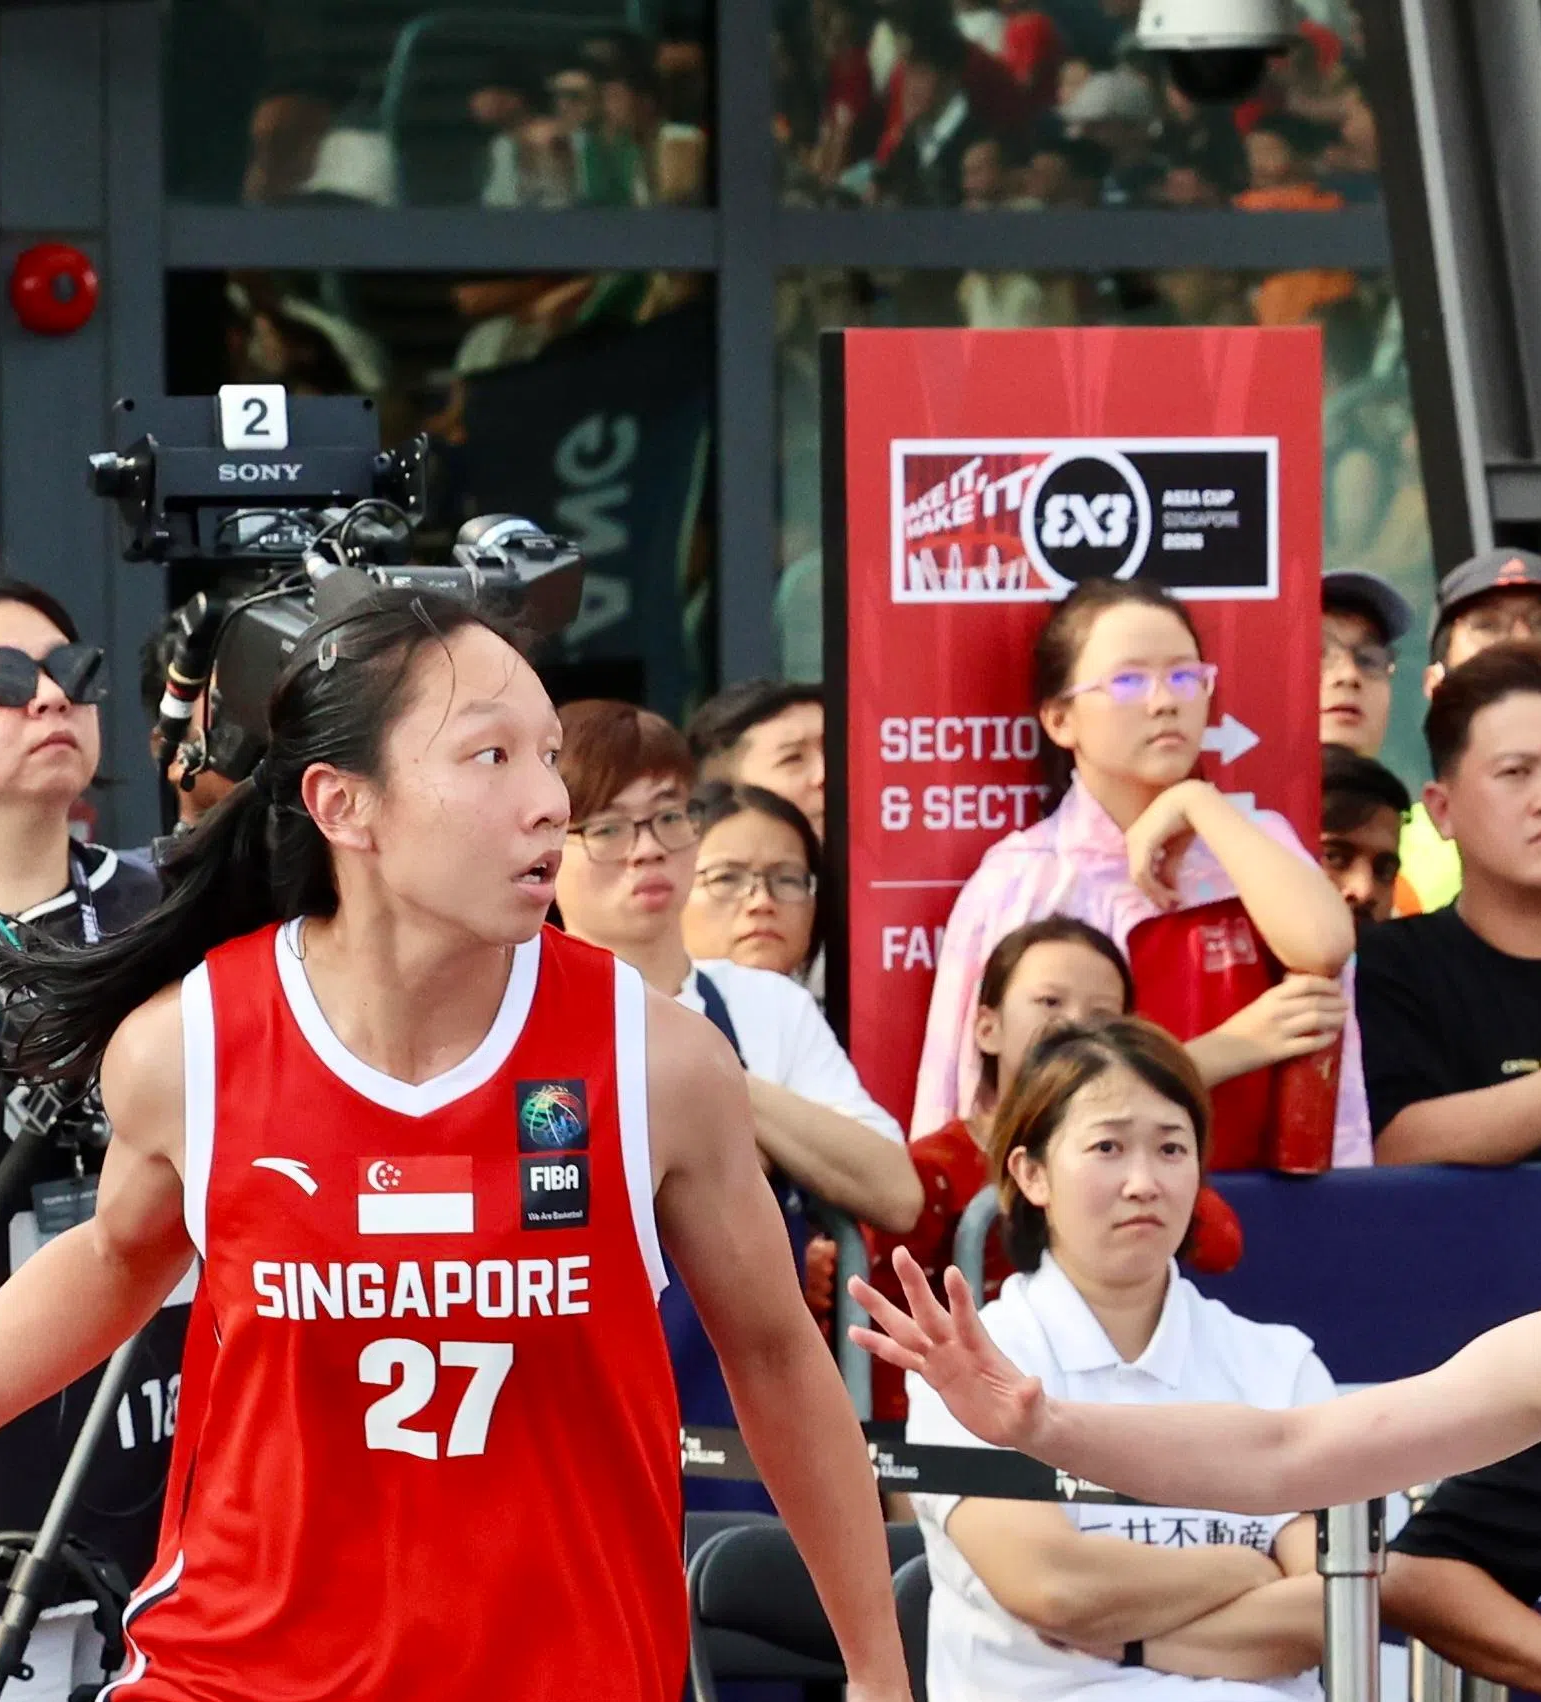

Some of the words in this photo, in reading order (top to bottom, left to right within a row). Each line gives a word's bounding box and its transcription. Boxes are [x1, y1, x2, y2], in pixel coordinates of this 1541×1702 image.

[242, 397, 271, 436] 2
[218, 463, 303, 483] SONY
[880, 716, 1041, 763] SECTIO
[880, 786, 913, 831] &
[881, 925, 945, 972] FA
[530, 1164, 580, 1192] FIBA
[252, 1255, 591, 1322] SINGAPORE
[358, 1337, 515, 1461] 27
